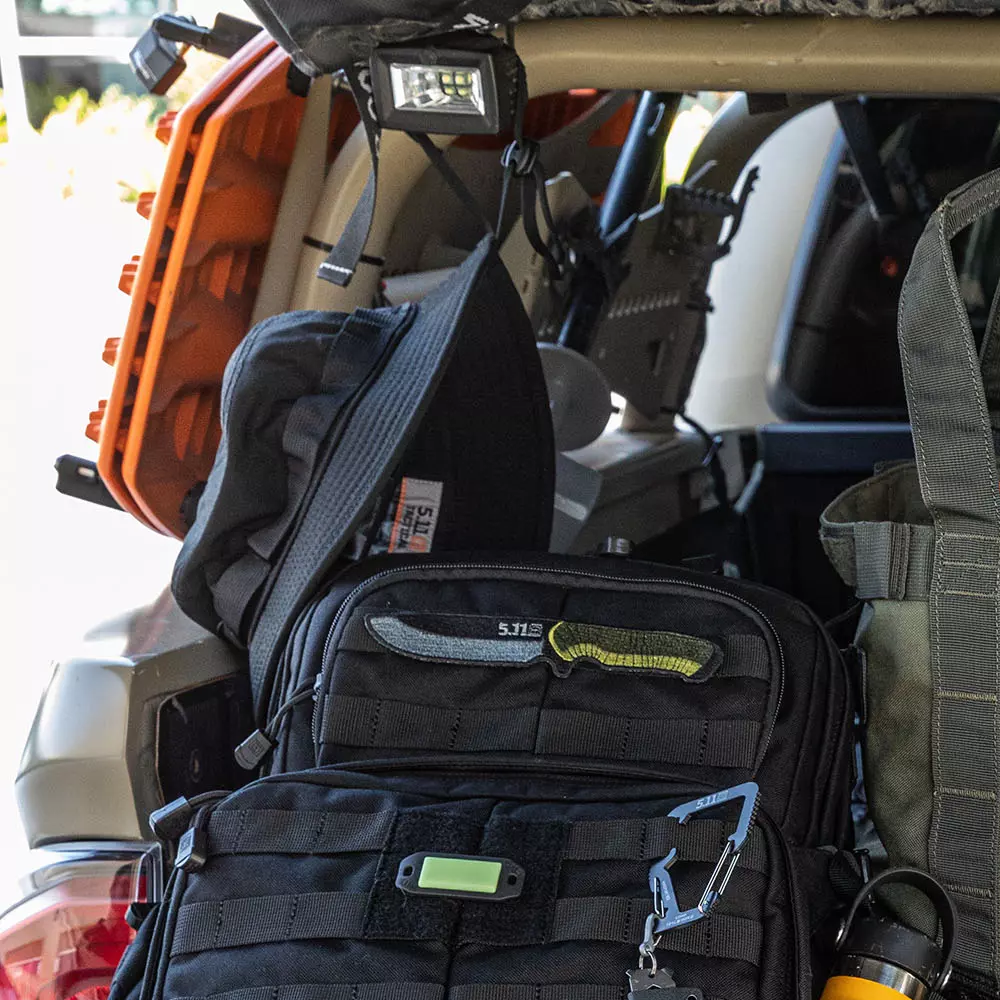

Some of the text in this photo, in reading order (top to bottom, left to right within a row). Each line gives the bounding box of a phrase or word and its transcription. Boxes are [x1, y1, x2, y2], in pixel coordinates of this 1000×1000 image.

[413, 505, 434, 535] 5.11
[498, 621, 528, 637] 5.11
[695, 793, 717, 810] 5.11
